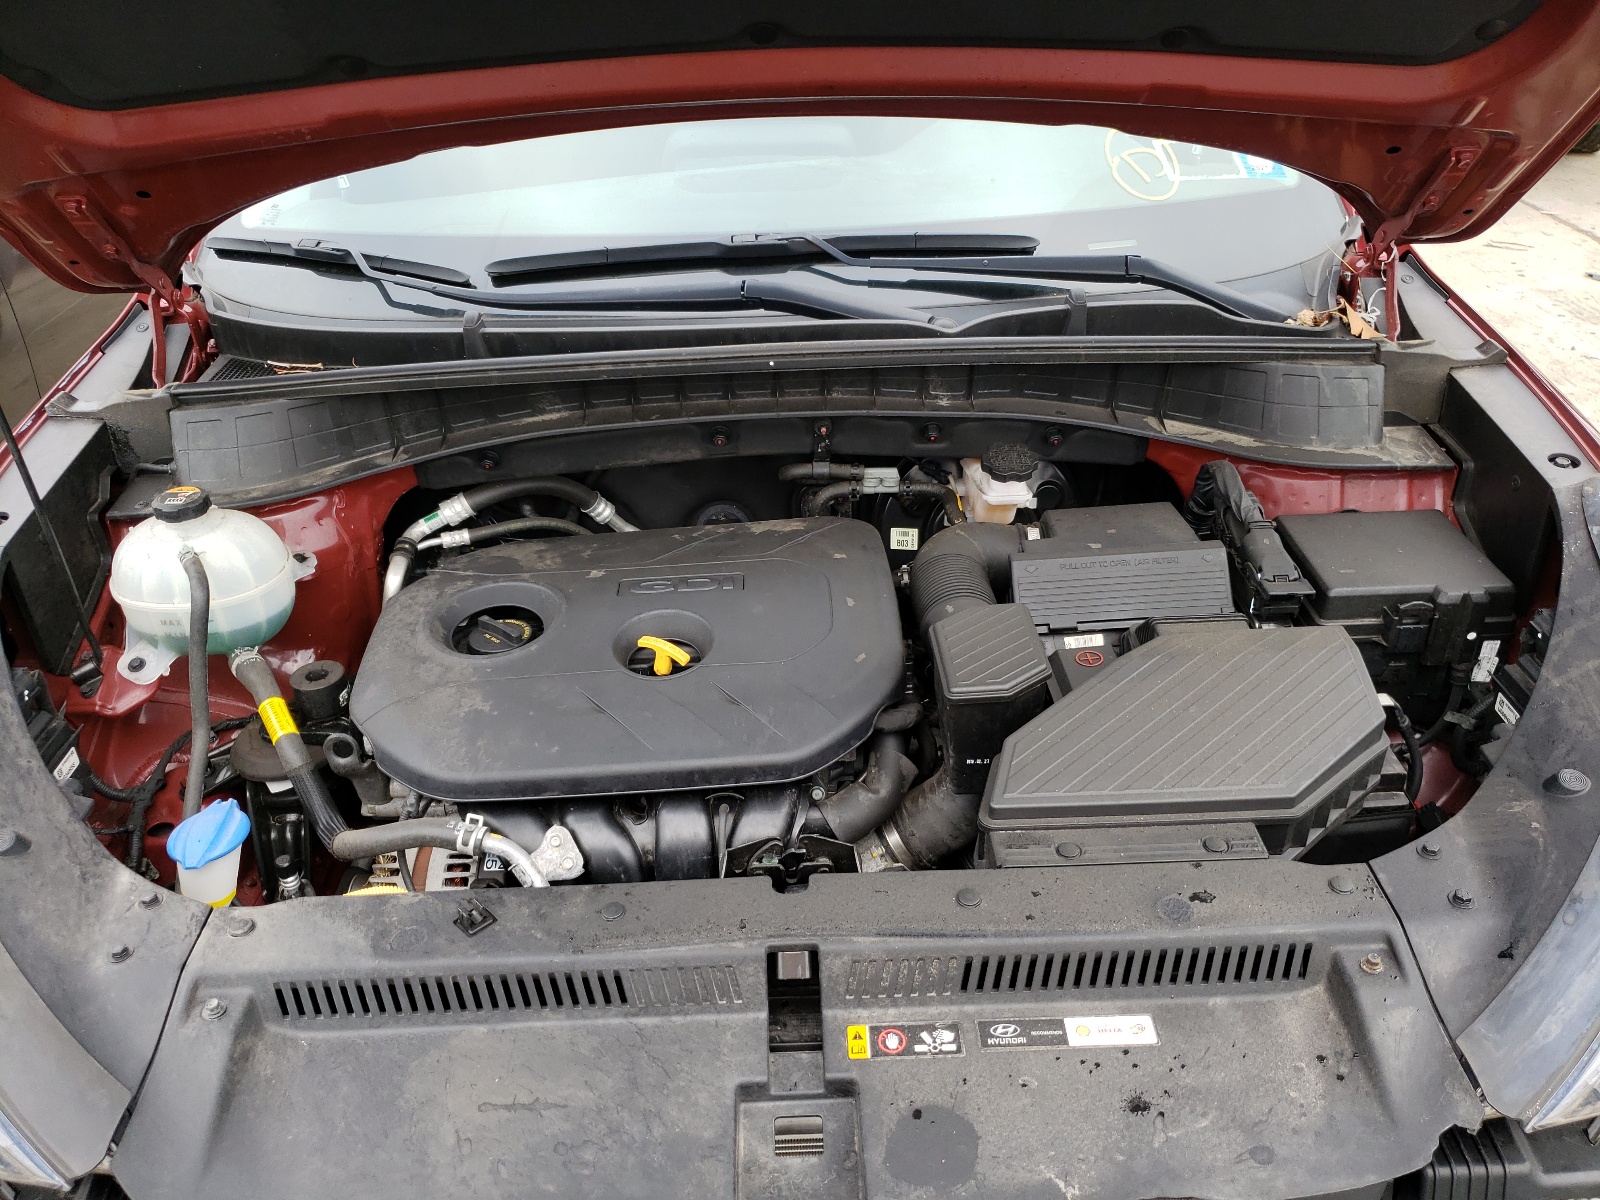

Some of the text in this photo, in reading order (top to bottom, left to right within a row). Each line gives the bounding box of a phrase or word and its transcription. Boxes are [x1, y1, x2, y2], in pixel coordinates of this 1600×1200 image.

[1059, 562, 1080, 571] PULL
[1081, 561, 1097, 569] OUT
[1098, 560, 1109, 568] TO
[1109, 559, 1132, 567] OPEN
[629, 576, 735, 594] GDI
[987, 1036, 1027, 1045] HYUNDAI
